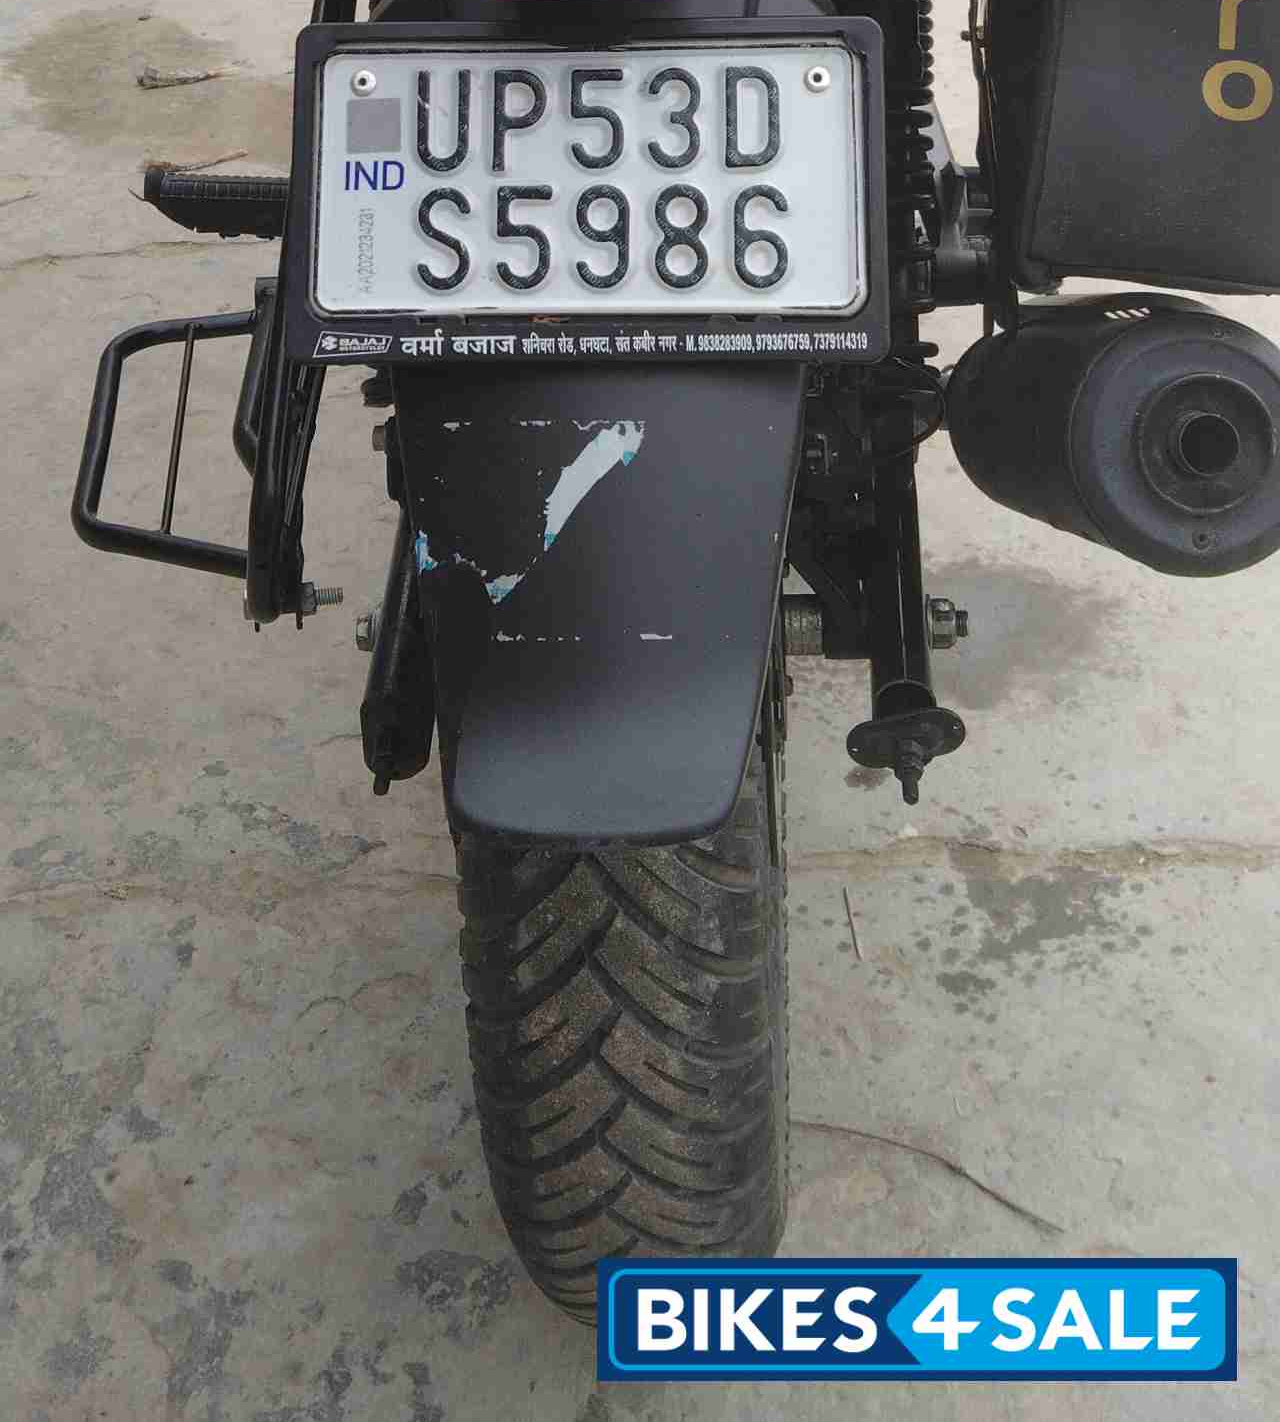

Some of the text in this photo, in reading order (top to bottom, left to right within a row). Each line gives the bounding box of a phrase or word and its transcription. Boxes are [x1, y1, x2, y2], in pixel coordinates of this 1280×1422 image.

[415, 66, 782, 171] UP53D
[344, 160, 405, 191] IND
[415, 184, 789, 291] S5986
[339, 337, 387, 346] BAJAJ
[400, 328, 517, 357] वर्मा बजाज
